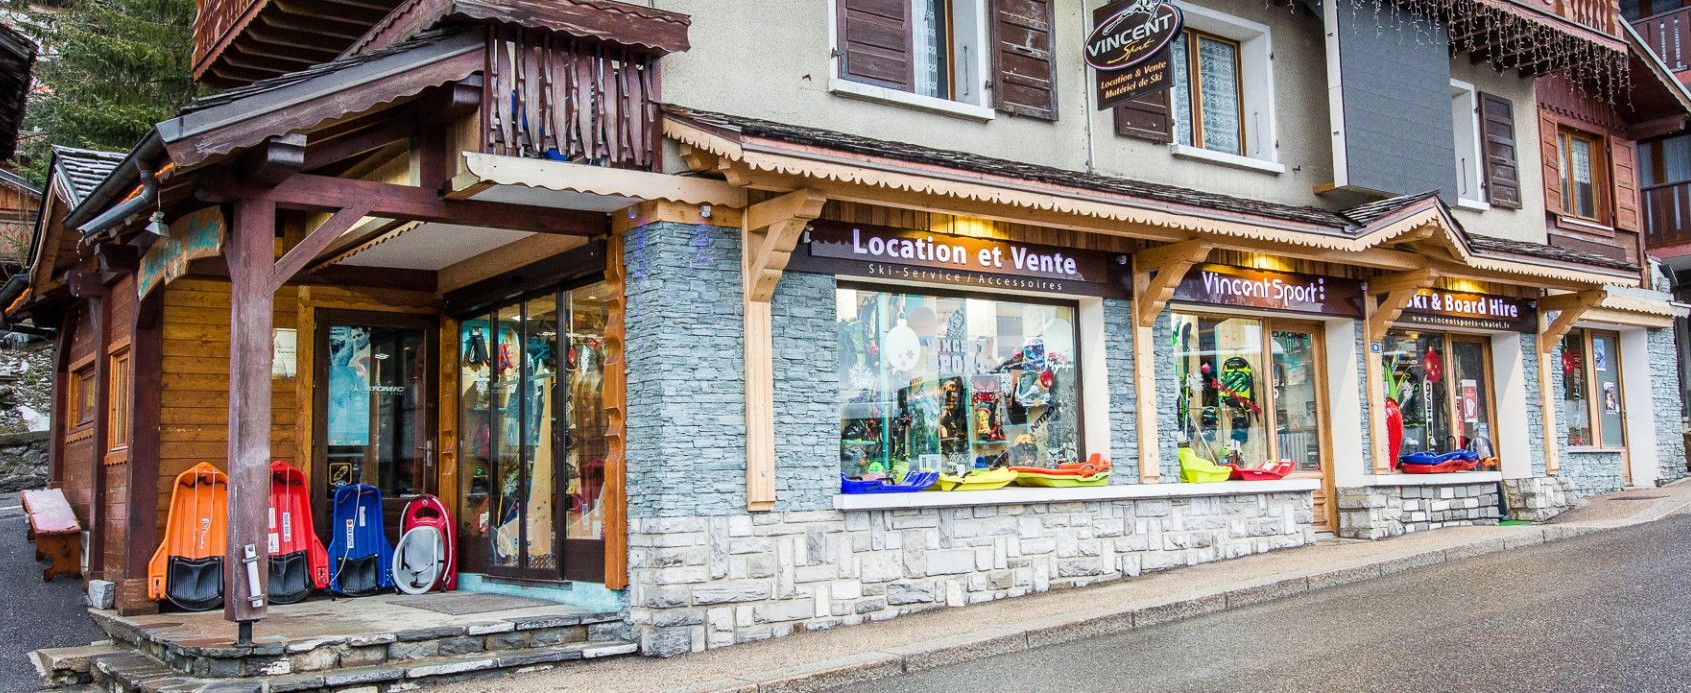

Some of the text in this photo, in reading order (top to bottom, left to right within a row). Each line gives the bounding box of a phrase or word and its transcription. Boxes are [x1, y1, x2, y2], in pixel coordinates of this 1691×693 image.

[1087, 13, 1173, 57] VINCENT
[1106, 38, 1155, 64] Sport
[1101, 60, 1167, 89] Location & Vente
[1105, 71, 1163, 99] Matériel de Ski
[853, 228, 1077, 275] Location et Vente
[868, 263, 960, 282] Ski-Service
[978, 274, 1063, 291] Accessoires
[1431, 292, 1442, 311] &
[1444, 294, 1488, 315] Board
[1489, 298, 1519, 318] Hire
[367, 385, 405, 393] ATOMIC
